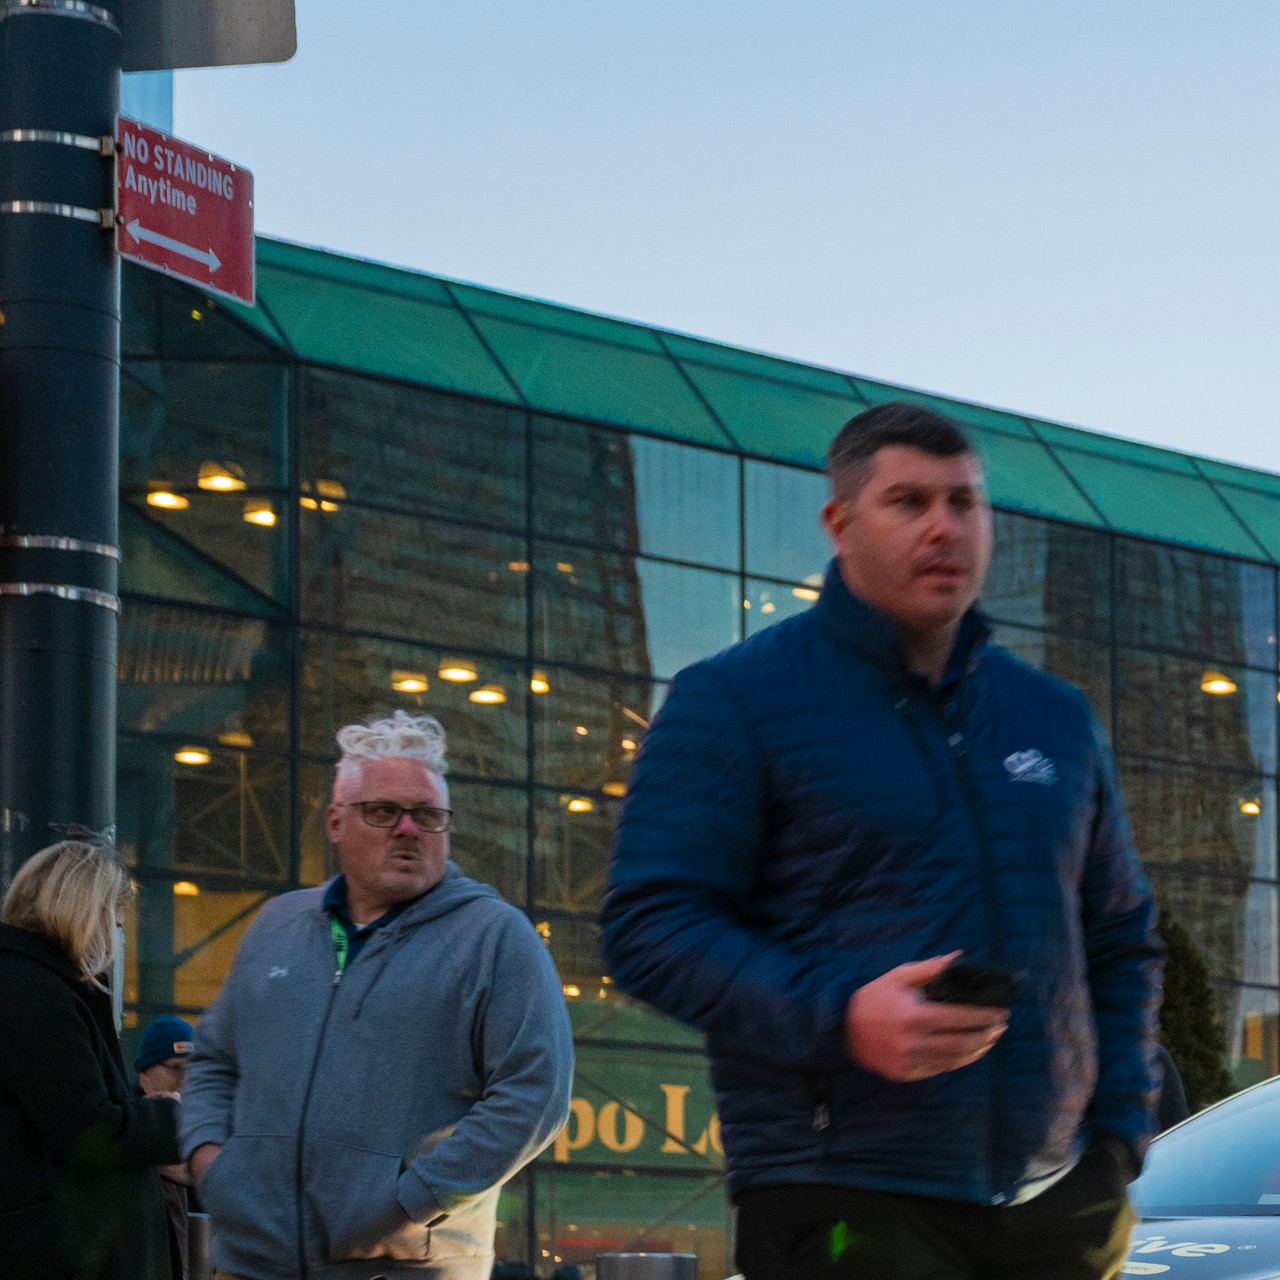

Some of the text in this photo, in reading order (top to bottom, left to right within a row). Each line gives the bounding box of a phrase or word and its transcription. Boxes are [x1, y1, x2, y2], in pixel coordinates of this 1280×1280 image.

[124, 132, 234, 201] NO STANDING
[125, 165, 197, 215] Anytime
